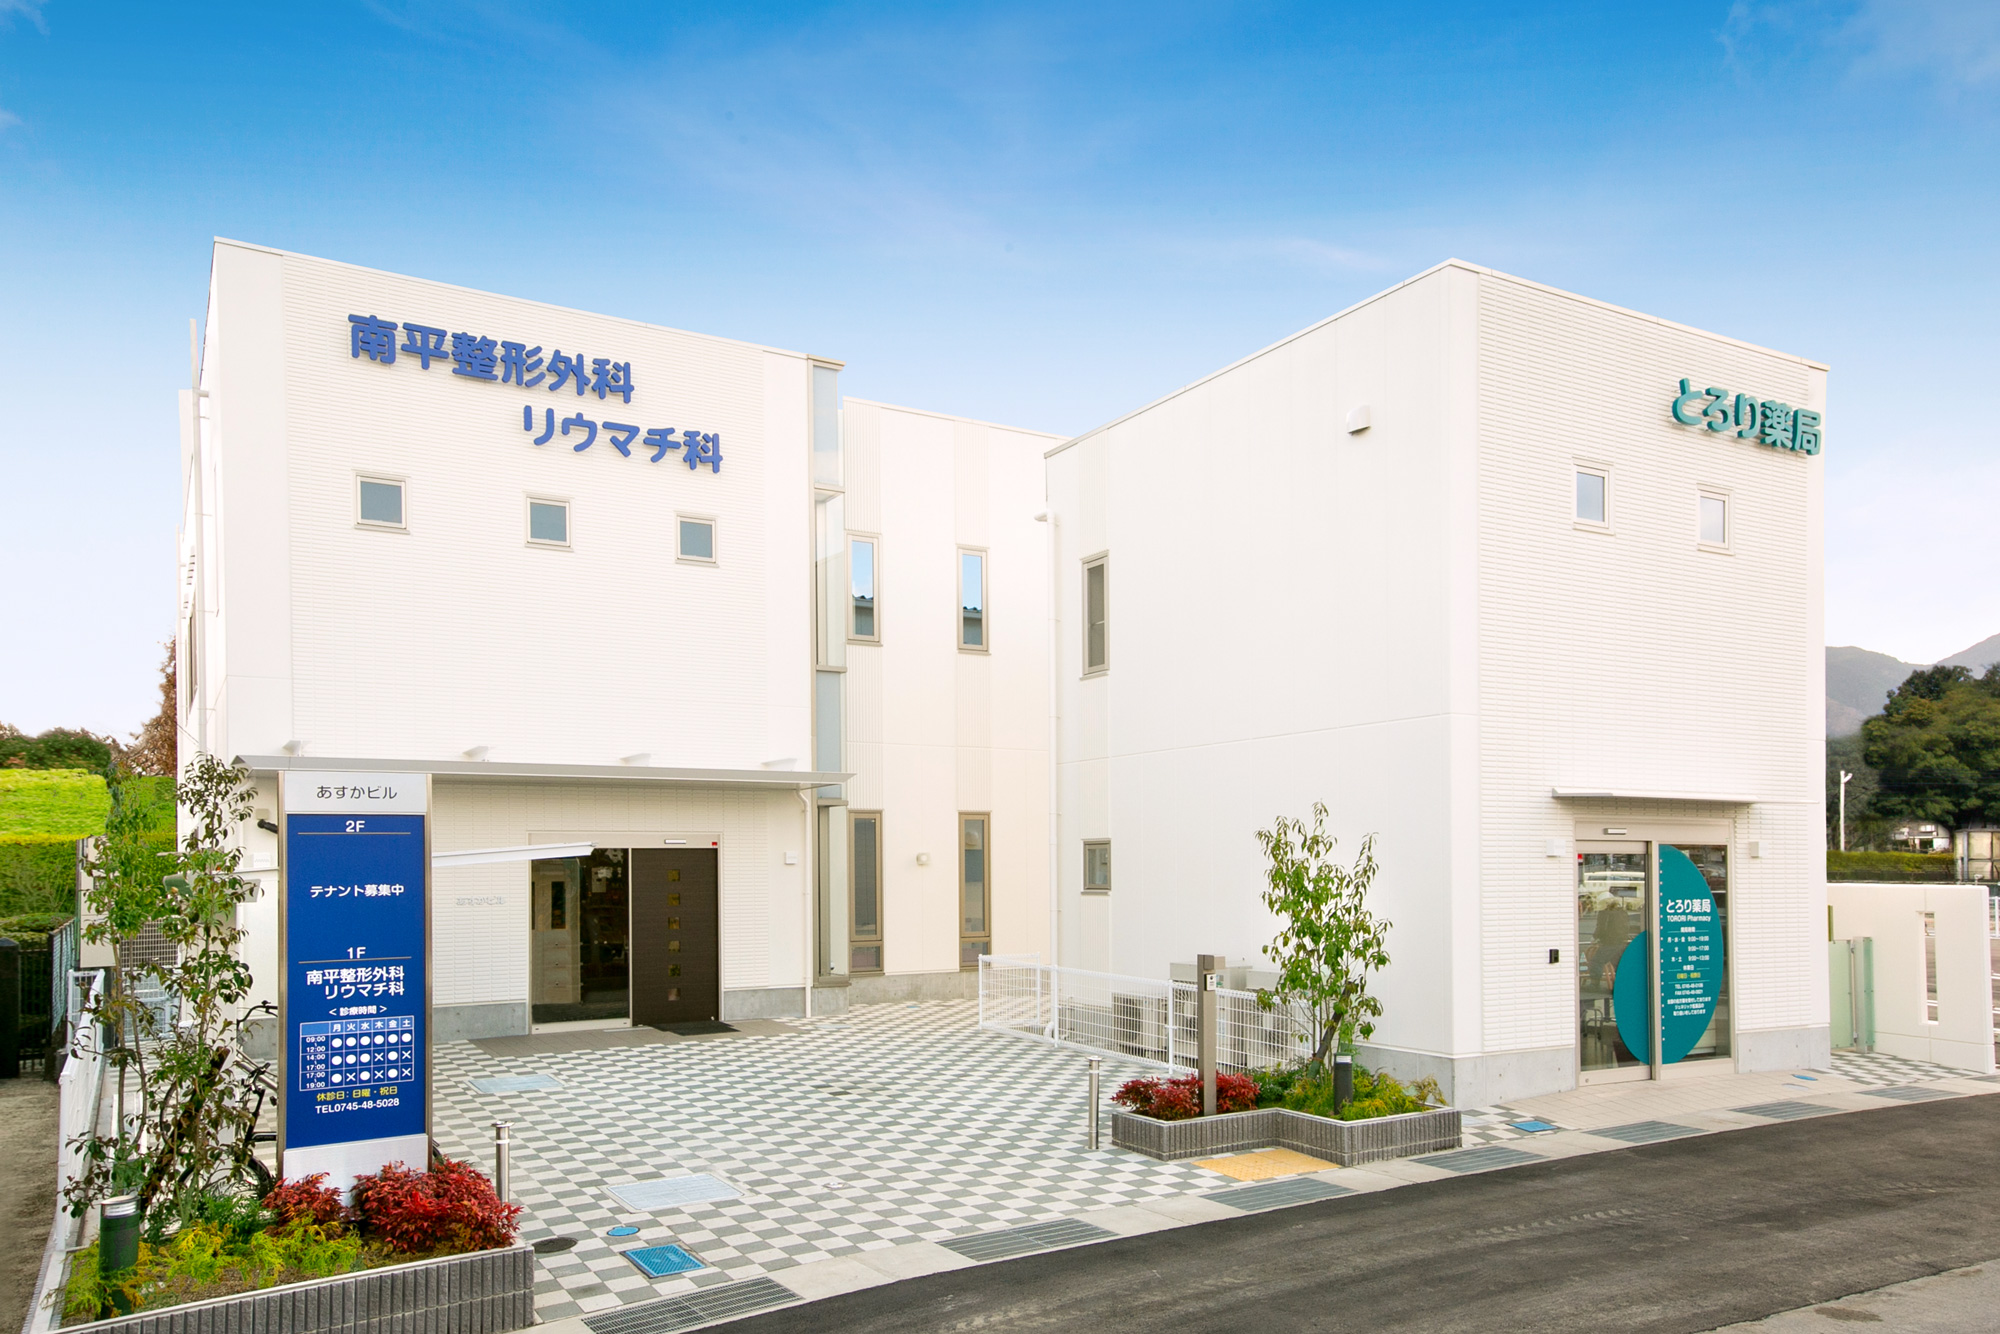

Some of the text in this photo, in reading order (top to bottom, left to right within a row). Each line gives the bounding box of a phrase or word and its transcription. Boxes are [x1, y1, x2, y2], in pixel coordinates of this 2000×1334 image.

[348, 314, 635, 404] 南平整形外科
[1672, 377, 1822, 455] とろり薬局
[523, 405, 723, 473] リウマチ科
[316, 785, 398, 799] あすかビル
[345, 820, 366, 832] 2F
[310, 883, 405, 898] テナント募集中
[1666, 898, 1711, 913] とろり薬局
[347, 946, 366, 959] 1F
[306, 965, 405, 986] 南平整形外科
[325, 981, 405, 999] リウマチ科
[333, 1019, 411, 1033] 月 火 水 木 金 土
[306, 1063, 326, 1071] 17:00
[306, 1071, 326, 1079] 17:00
[306, 1081, 326, 1089] 19:00
[315, 1098, 400, 1114] TEL0745-48-5028
